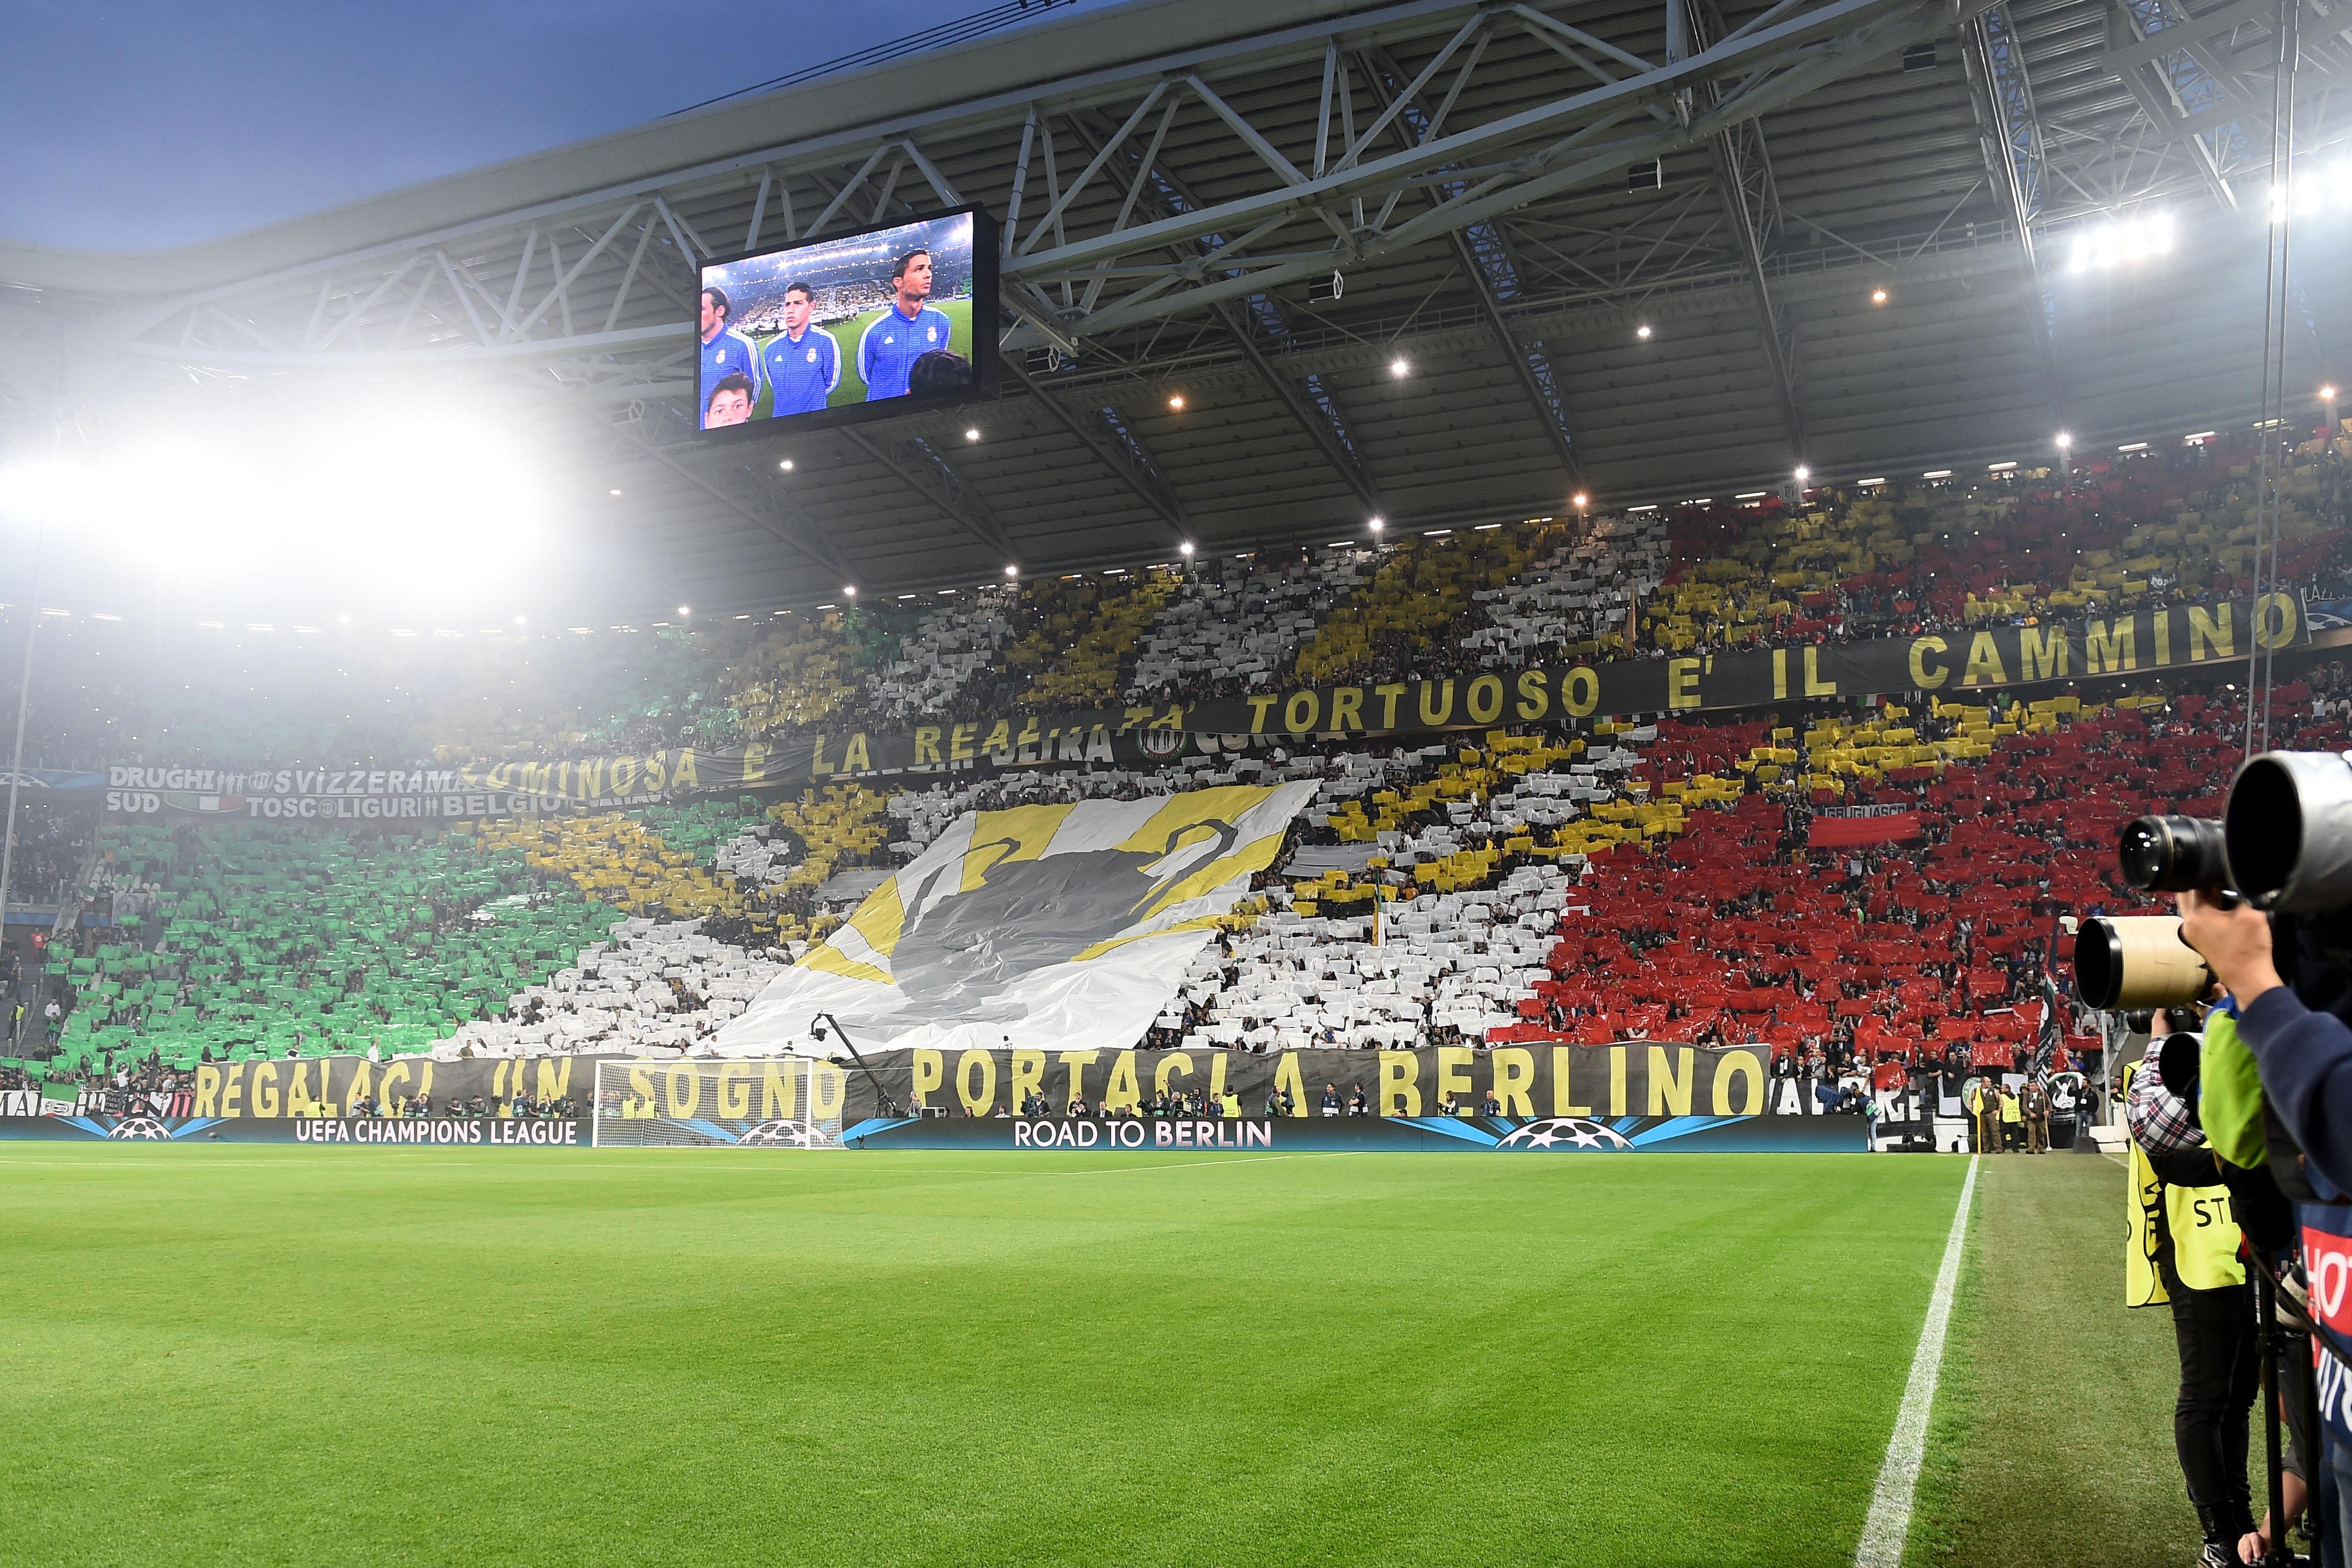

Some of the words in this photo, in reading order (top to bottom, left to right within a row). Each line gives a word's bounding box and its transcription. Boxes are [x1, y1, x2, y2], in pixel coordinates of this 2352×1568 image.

[810, 733, 871, 775] LA
[1247, 667, 1601, 733] TORTUOSO
[1772, 646, 1837, 699] IL
[1908, 592, 2297, 688] CAMMINO
[110, 766, 214, 789] DRUGHI
[274, 769, 423, 794] SVIZZERA
[106, 793, 160, 813] SUD
[195, 1058, 434, 1118] REGALACI
[492, 1057, 572, 1118] UN
[628, 1054, 847, 1120] SOGNO
[912, 1049, 1228, 1118] PORTACI
[1272, 1052, 1308, 1118] A
[1379, 1046, 1764, 1117] BERLINO
[296, 1119, 350, 1143] UEFA
[355, 1119, 482, 1144] CHAMPIONS
[490, 1120, 577, 1145] LEAGUE
[1014, 1120, 1098, 1147] ROAD
[1105, 1120, 1146, 1147] TO
[1155, 1120, 1272, 1147] BERLIN
[2194, 1196, 2232, 1228] ST
[2302, 1244, 2352, 1319] HO
